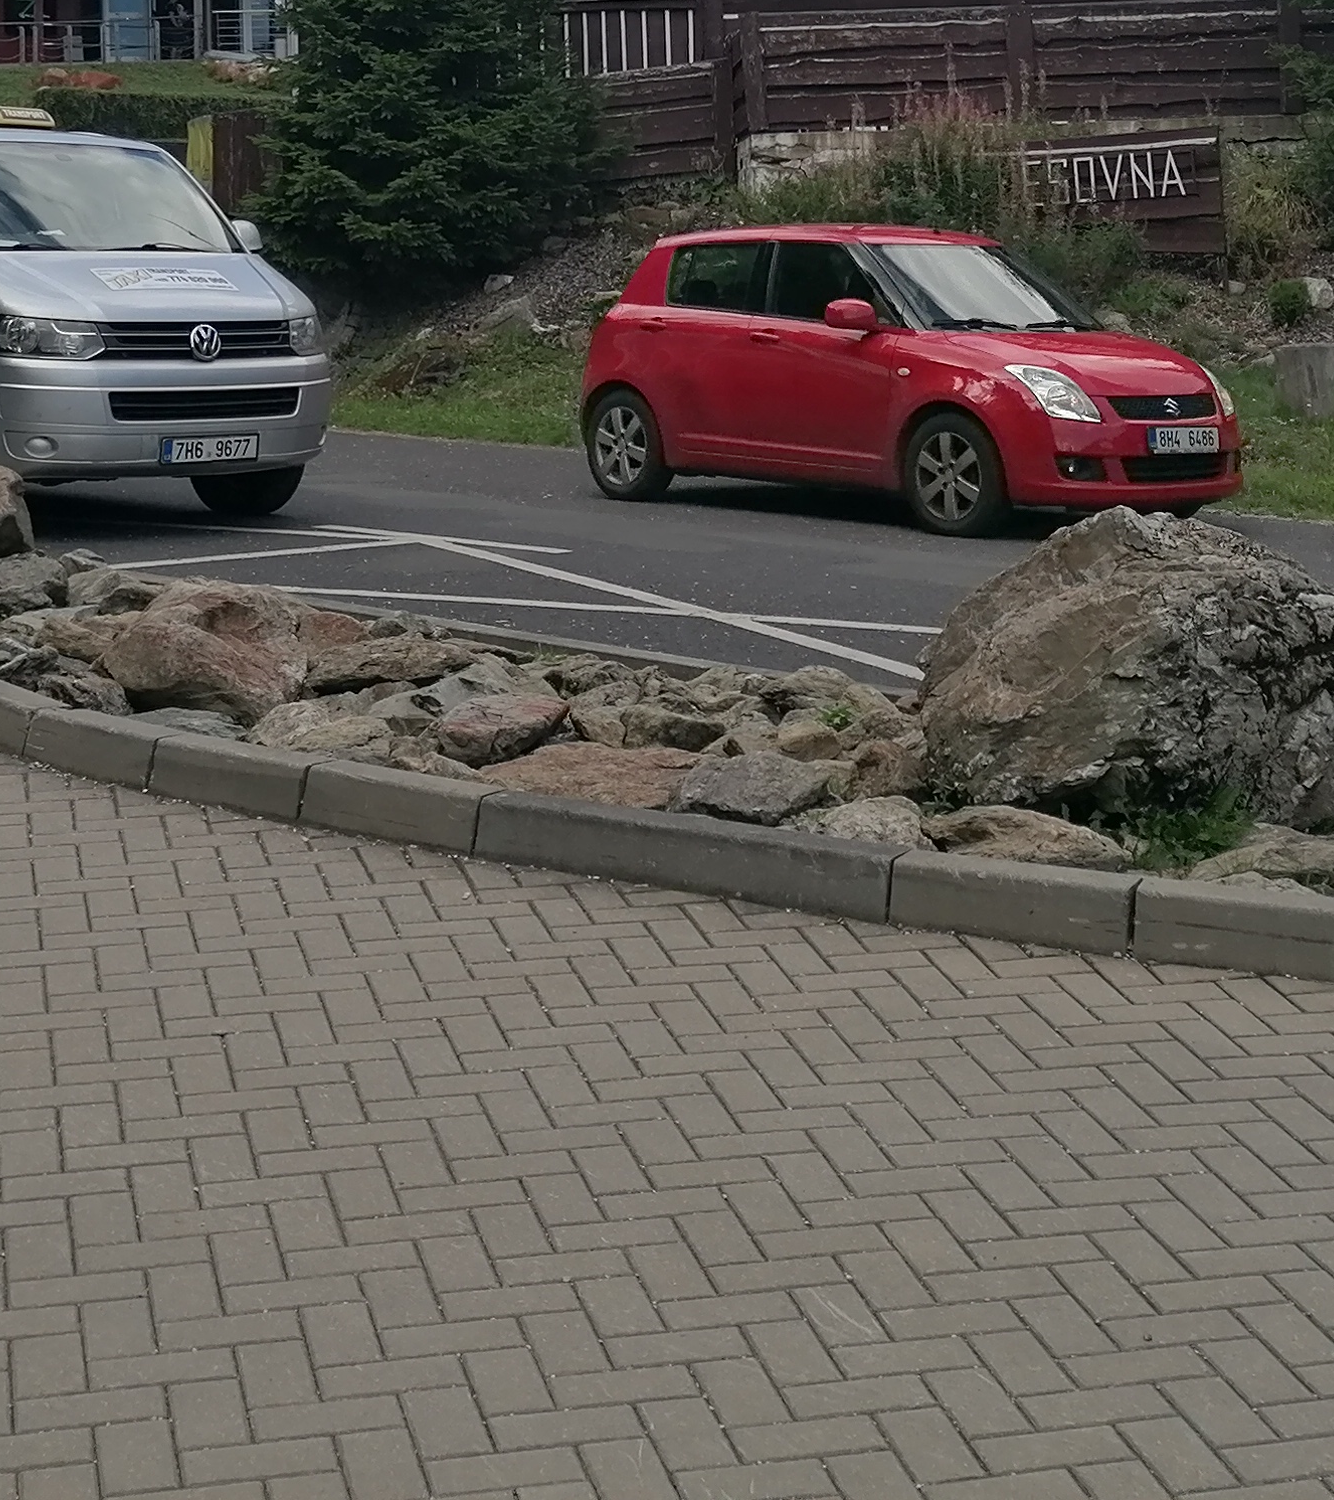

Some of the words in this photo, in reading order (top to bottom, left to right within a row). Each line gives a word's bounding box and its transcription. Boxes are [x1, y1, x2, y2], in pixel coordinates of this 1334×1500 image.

[1, 109, 49, 120] TRANSPORT
[107, 268, 153, 288] TAXI
[1159, 429, 1181, 448] 8H4
[1188, 429, 1215, 448] 6486
[176, 441, 204, 460] 7H6
[215, 439, 251, 458] 9677
